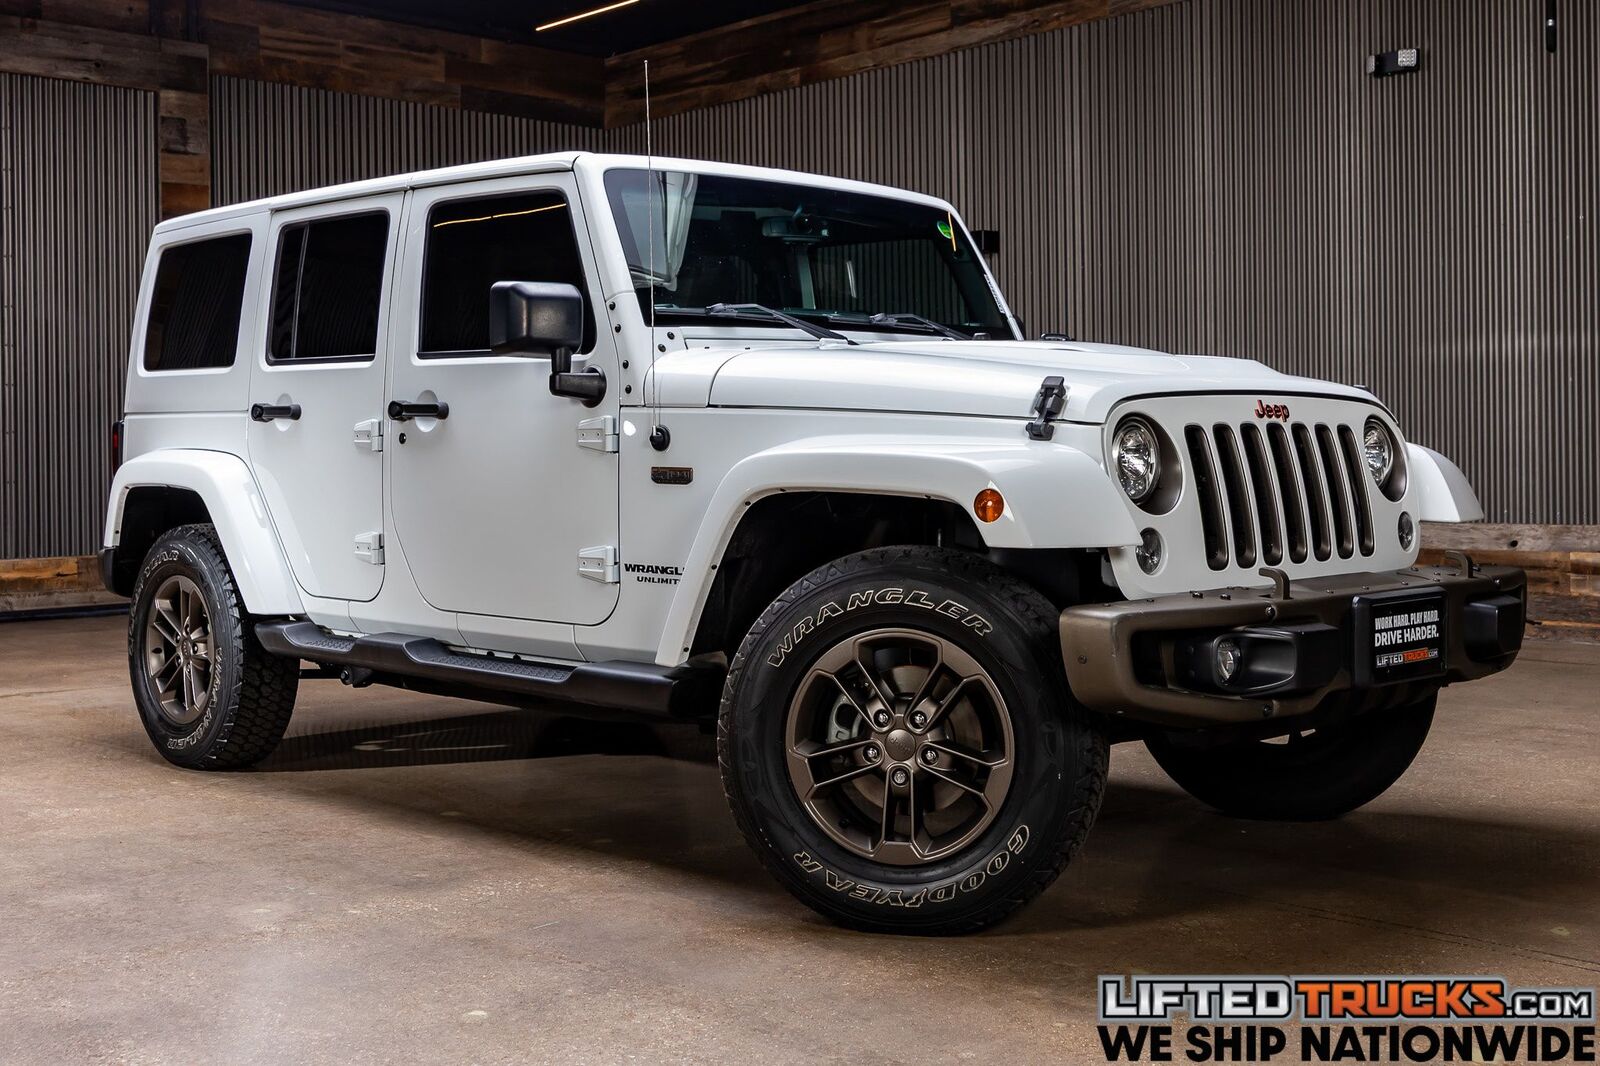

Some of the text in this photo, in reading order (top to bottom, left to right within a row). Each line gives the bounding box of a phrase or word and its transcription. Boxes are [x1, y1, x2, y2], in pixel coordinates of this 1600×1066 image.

[1255, 400, 1290, 422] Jeep
[624, 563, 684, 576] WRANGL
[767, 588, 993, 667] WRANGLER
[1374, 610, 1439, 630] WORK HARD. PLAY HARD.
[1374, 624, 1439, 647] DRIVE HARDER.
[793, 825, 1030, 908] GOODYEAR
